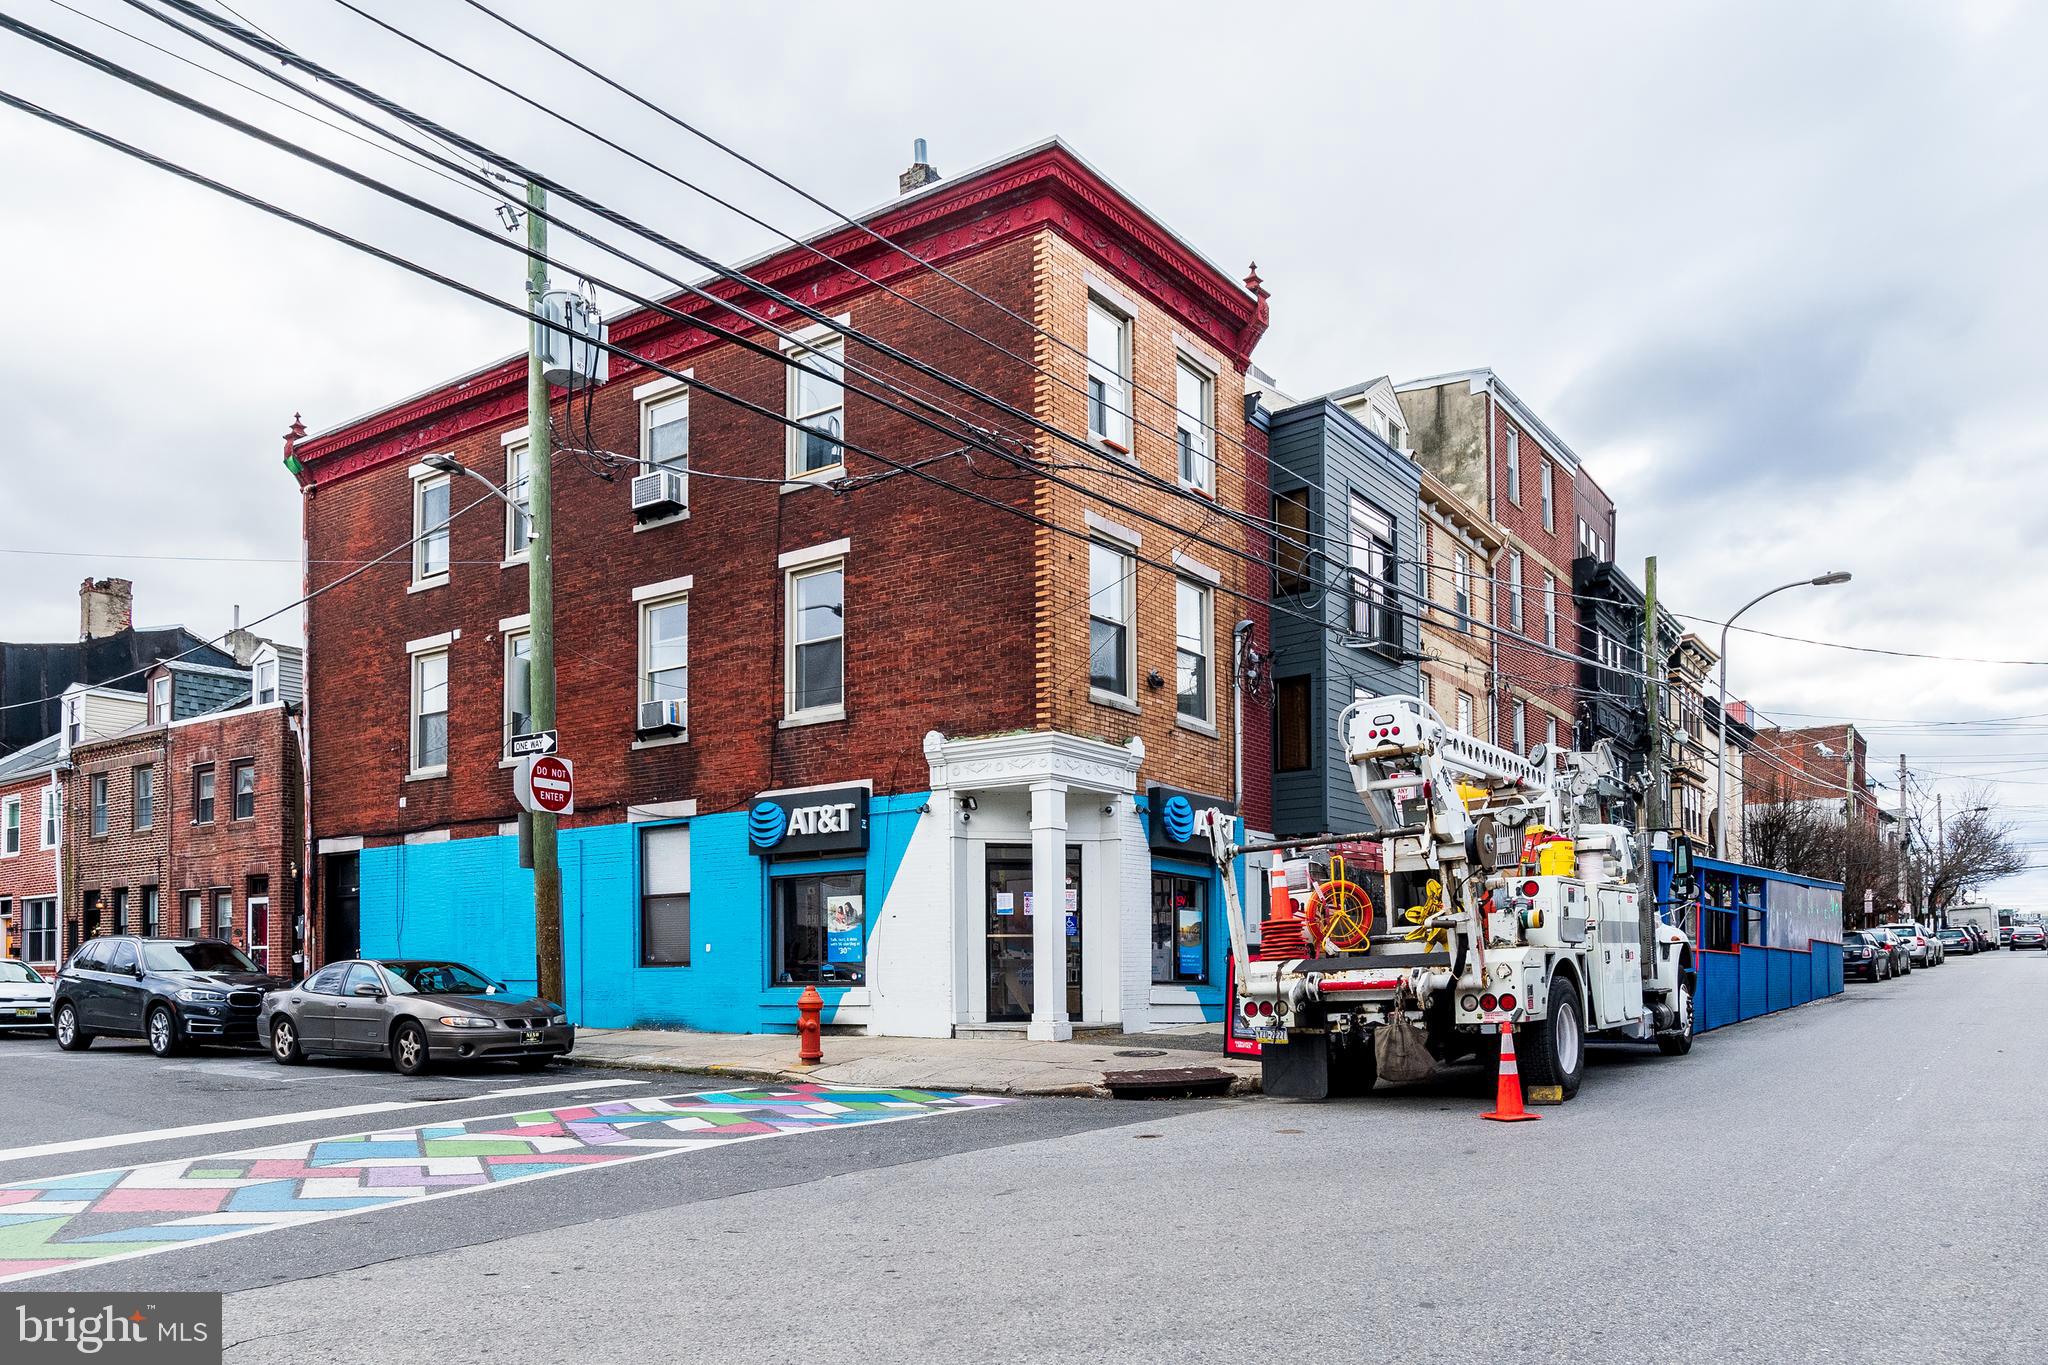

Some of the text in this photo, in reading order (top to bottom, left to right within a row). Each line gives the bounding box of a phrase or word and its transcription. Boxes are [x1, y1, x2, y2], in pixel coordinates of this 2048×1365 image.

[515, 739, 543, 751] ONE WAY
[536, 765, 566, 779] DO NOT
[540, 791, 564, 802] ENTER
[786, 803, 856, 836] AT&T
[1192, 809, 1238, 840] AT
